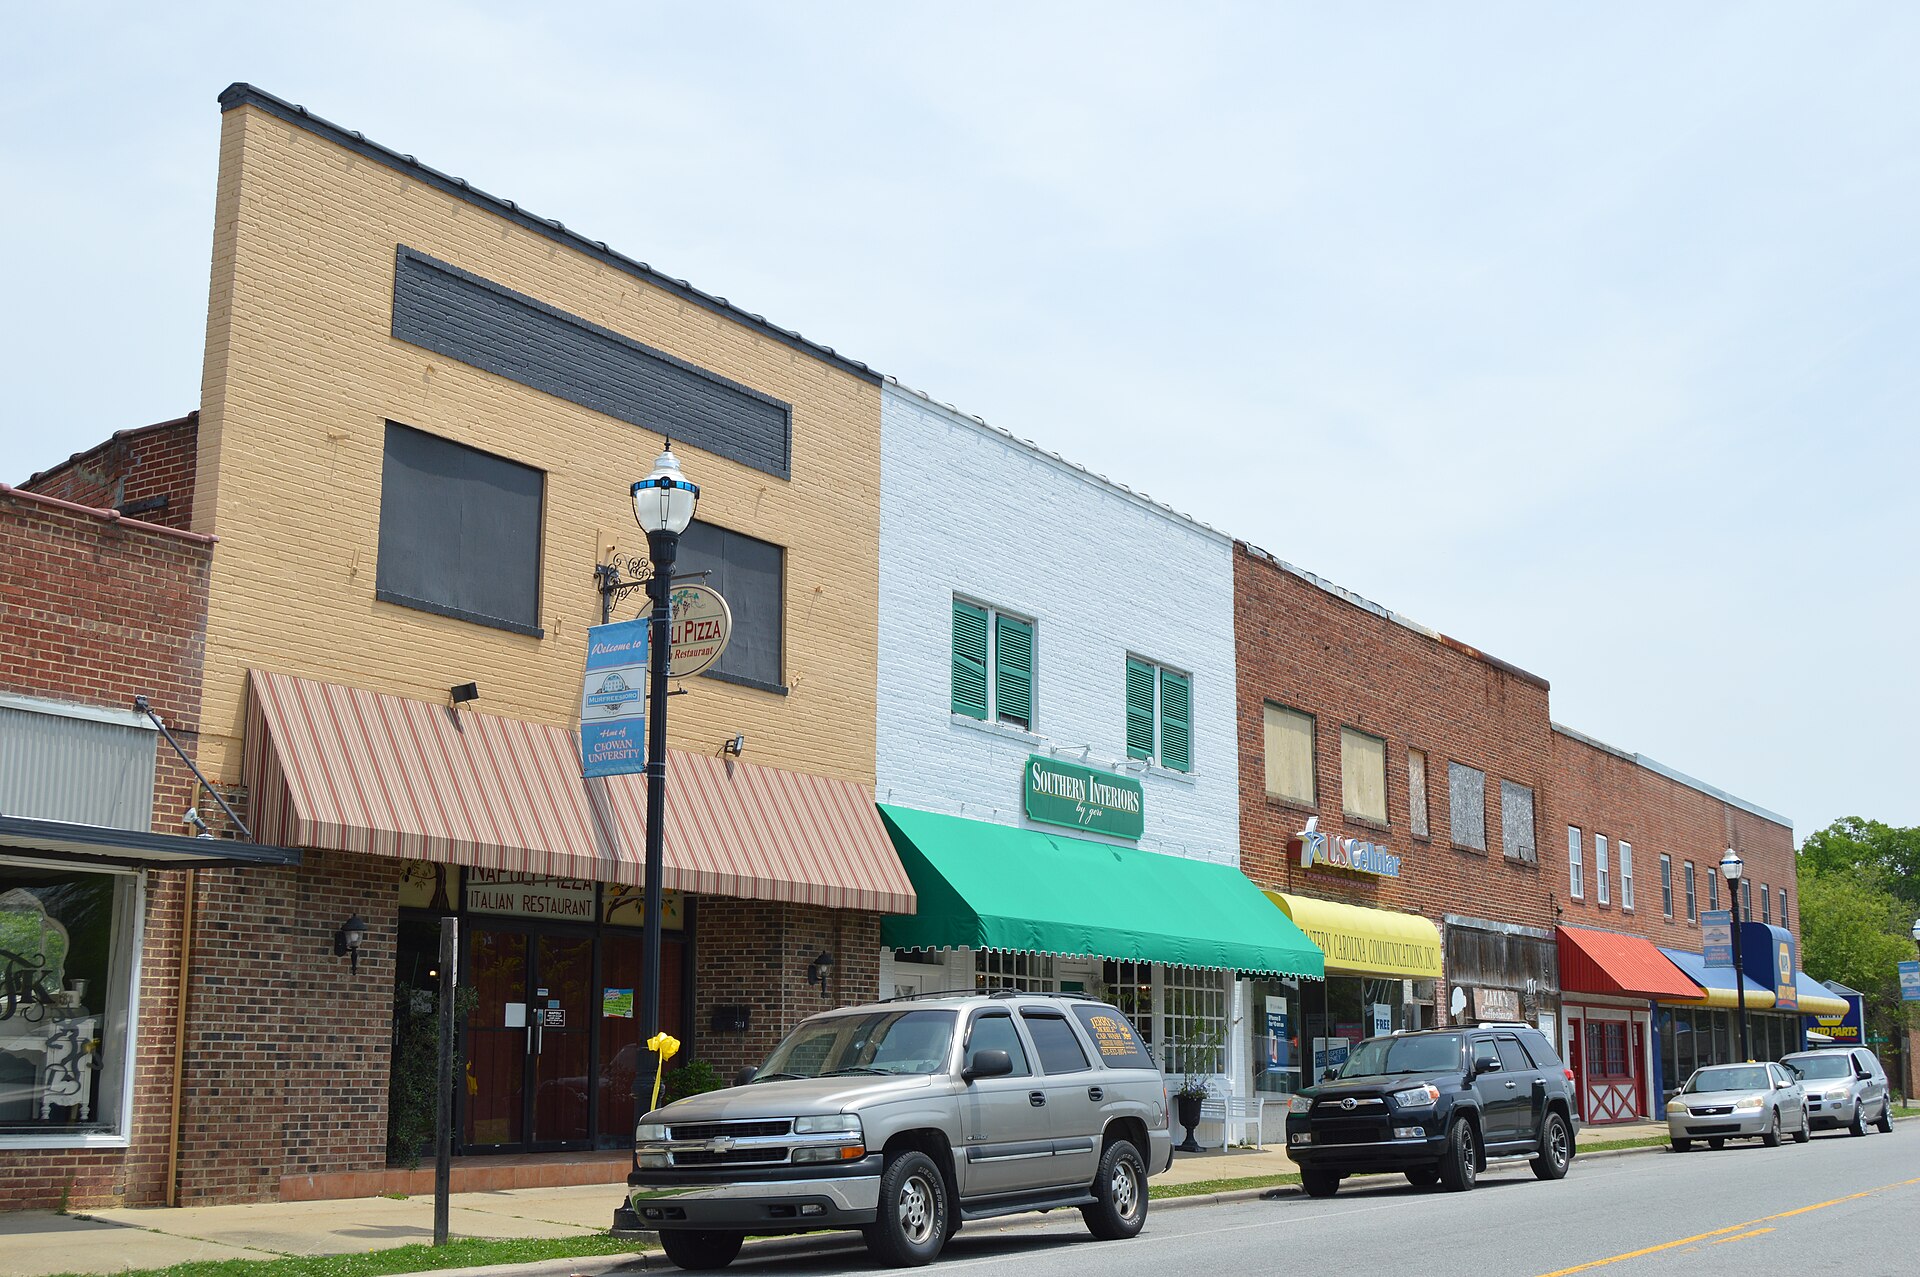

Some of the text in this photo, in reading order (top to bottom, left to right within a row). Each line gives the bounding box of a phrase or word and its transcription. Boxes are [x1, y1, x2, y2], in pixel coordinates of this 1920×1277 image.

[684, 620, 721, 643] PIZZA
[591, 640, 642, 655] Welcome to
[675, 646, 714, 660] Restaurant
[588, 691, 637, 704] MURFREESBORO
[588, 749, 640, 763] UNIVERSITY
[1075, 801, 1086, 823] by
[1349, 838, 1400, 877] Cellular
[470, 890, 592, 917] ITALIAN RESTAURANT
[1333, 934, 1367, 963] CAROLINA
[1090, 1016, 1118, 1030] JERRY'S
[1376, 1018, 1390, 1031] FREE
[1831, 1026, 1858, 1037] PARTS
